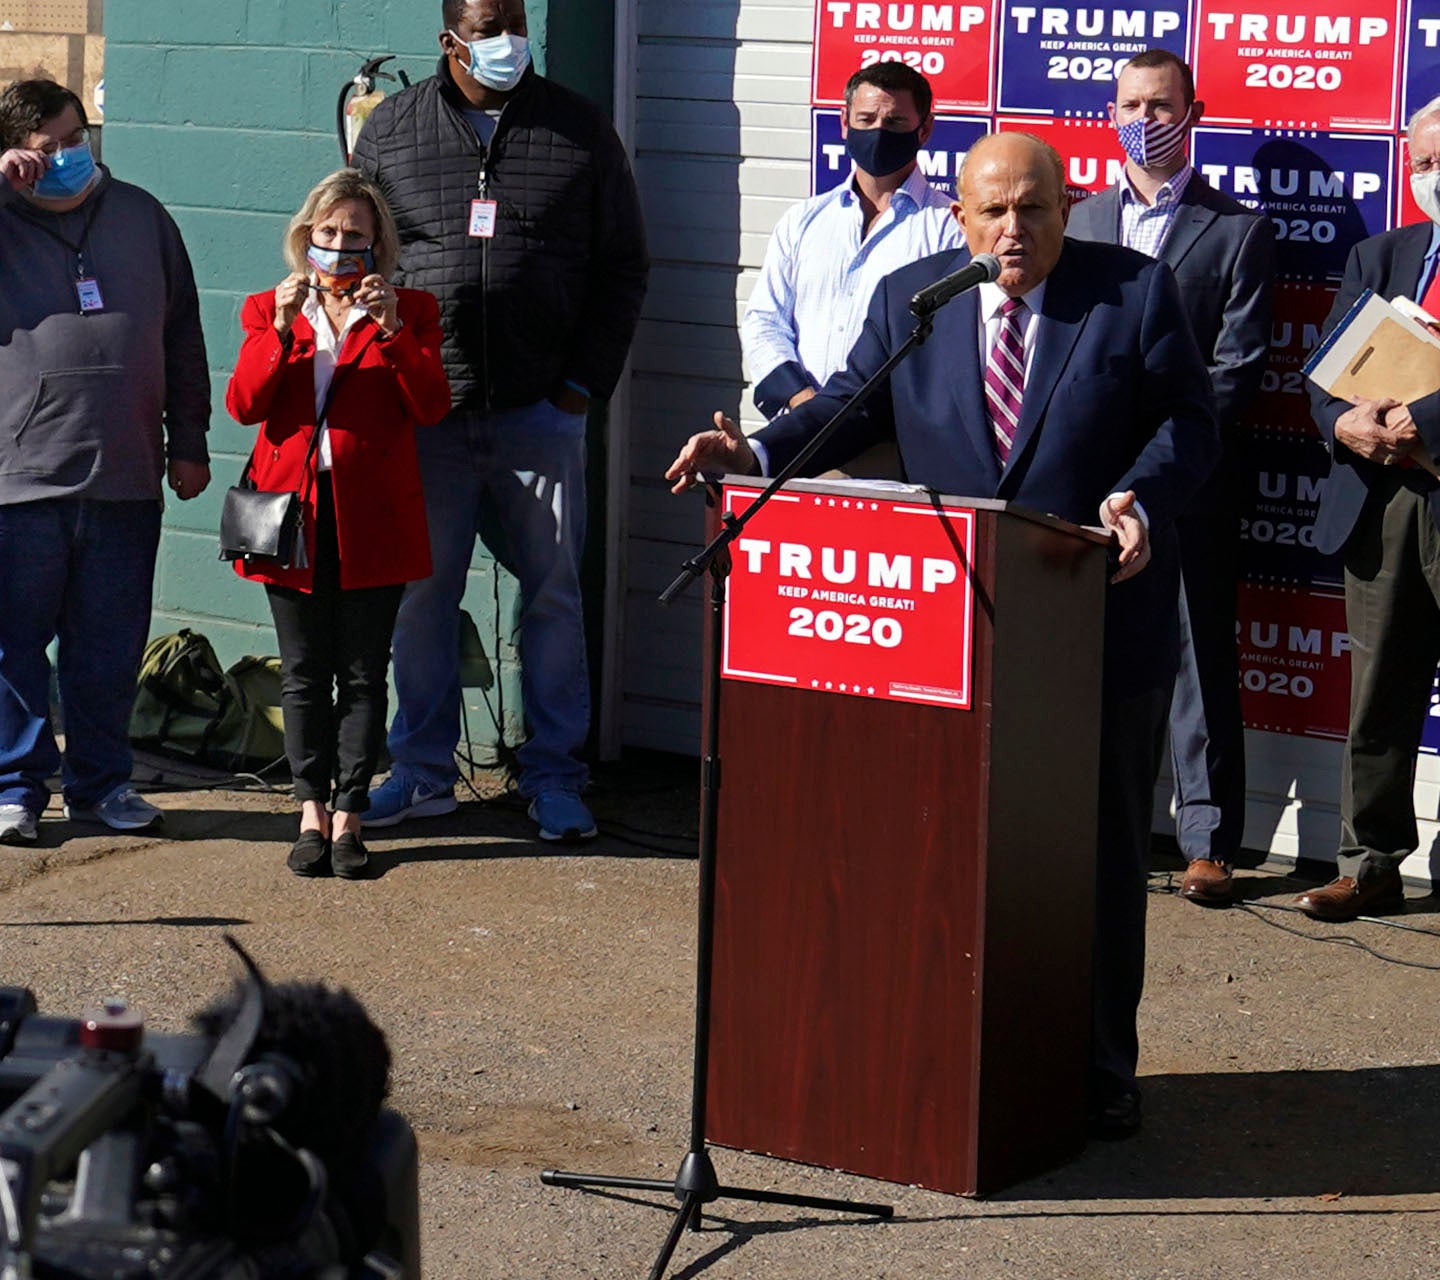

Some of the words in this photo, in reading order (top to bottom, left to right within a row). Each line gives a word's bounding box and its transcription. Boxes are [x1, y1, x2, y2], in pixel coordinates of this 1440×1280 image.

[828, 2, 984, 31] TRUMP
[1011, 7, 1179, 37] TRUMP
[1208, 13, 1387, 44] TRUMP
[854, 35, 876, 43] KEEP
[879, 36, 919, 44] AMERICA
[922, 37, 954, 45] GREAT!
[1041, 41, 1065, 49] KEEP
[1067, 42, 1110, 51] AMERICA
[1113, 43, 1146, 52] GREAT!
[1238, 48, 1264, 56] KEEP
[1266, 49, 1311, 58] AMERICA
[1315, 50, 1352, 59] GREAT!
[1246, 64, 1341, 90] 2020
[1202, 164, 1381, 200] TRUMP
[1262, 201, 1305, 213] AMERICA
[1308, 203, 1347, 214] GREAT!
[1275, 218, 1336, 244] 020
[740, 539, 956, 595] TRUMP
[779, 586, 808, 597] KEEP
[811, 590, 865, 605] AMERICA
[870, 596, 914, 610] GREAT!
[789, 606, 903, 647] 2020
[1235, 621, 1352, 658] UMP
[1288, 656, 1325, 671] GREAT!
[1241, 671, 1314, 699] 020
